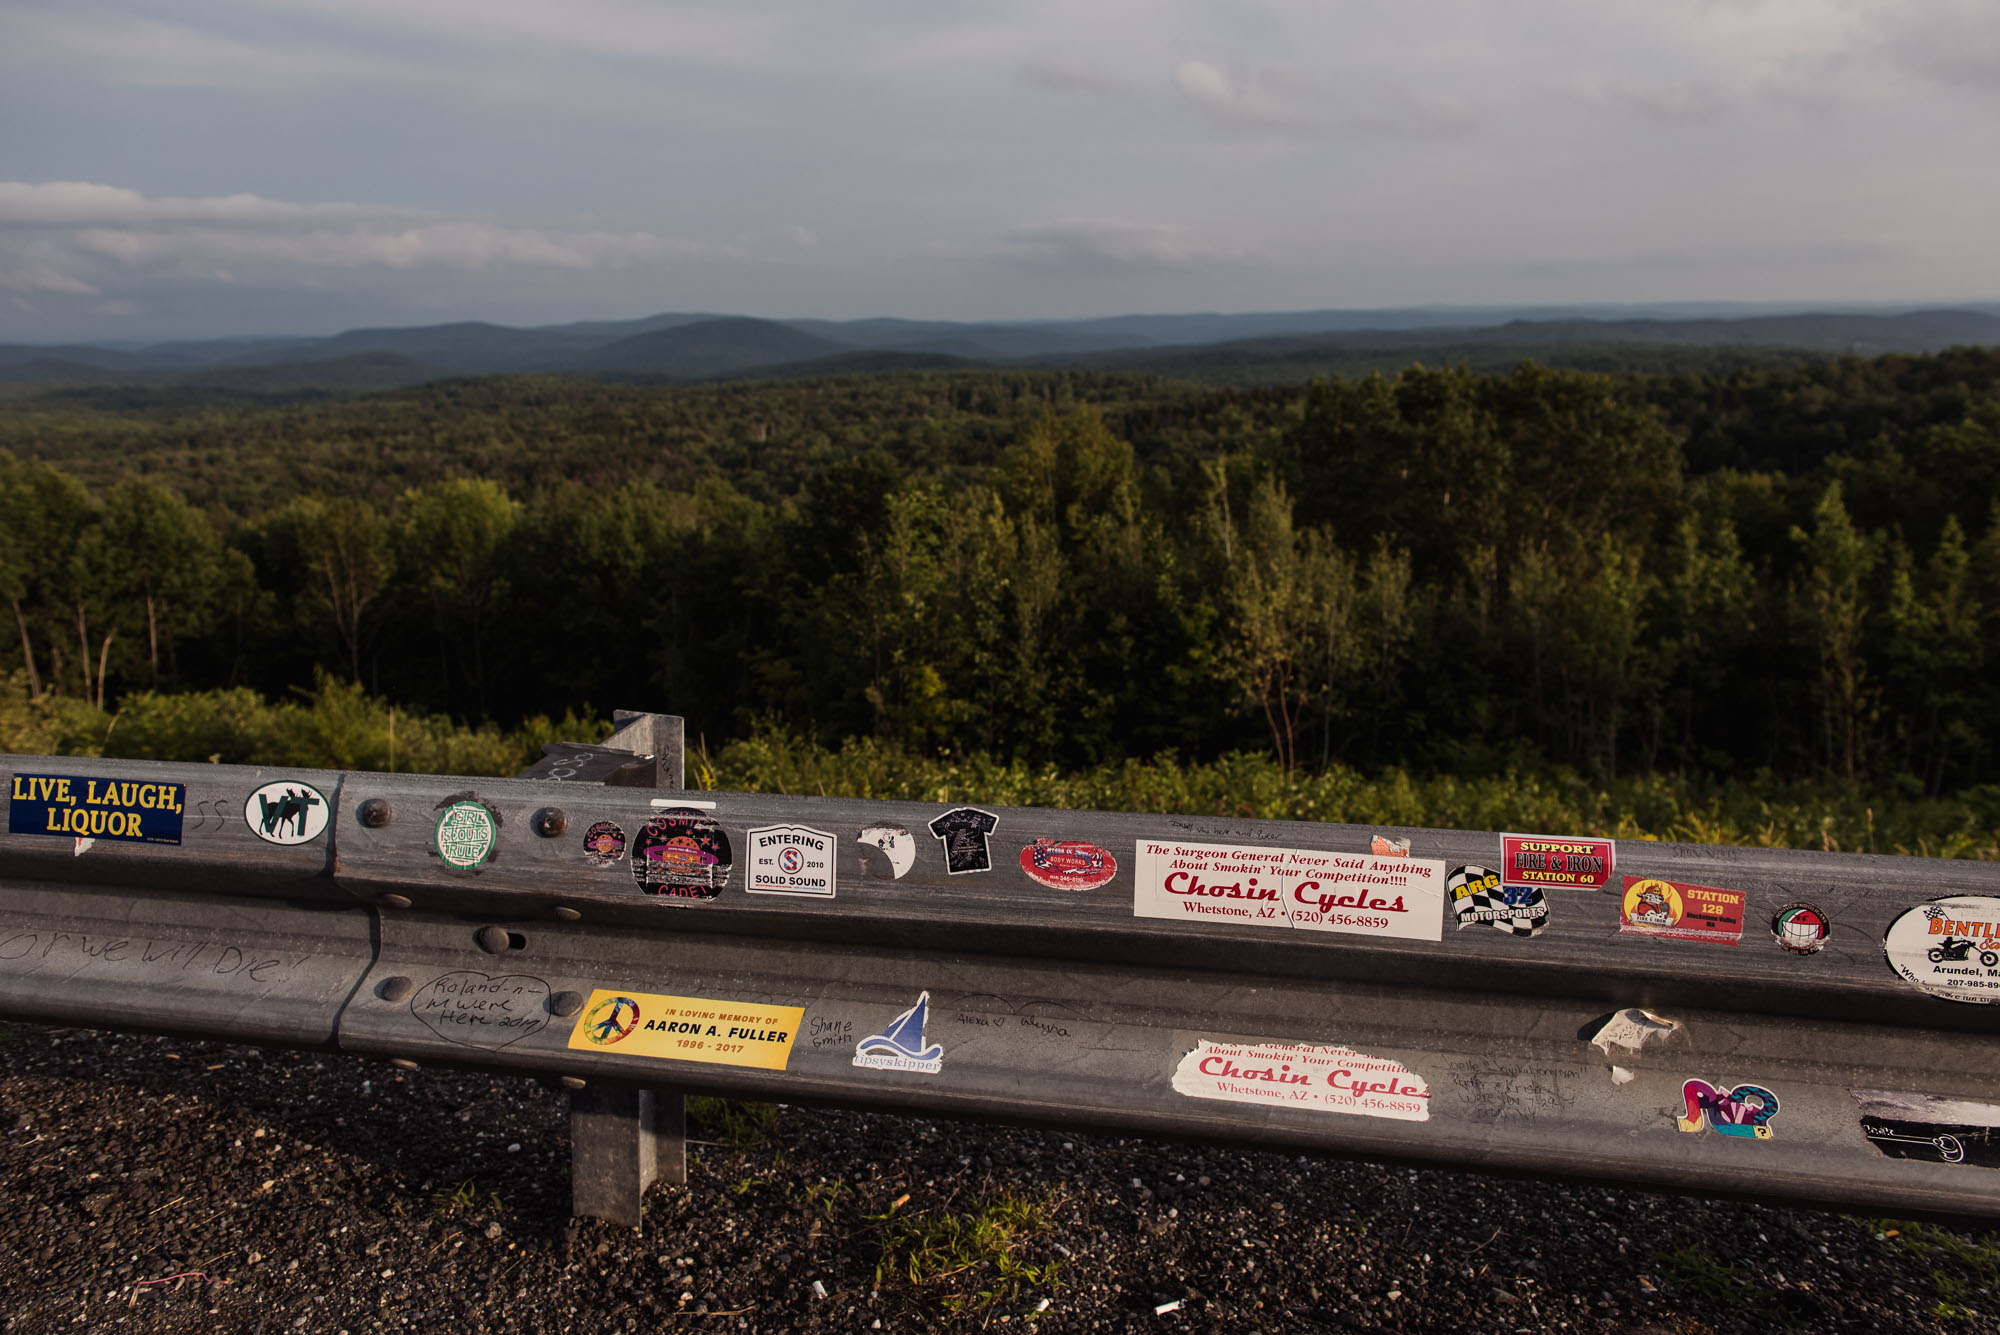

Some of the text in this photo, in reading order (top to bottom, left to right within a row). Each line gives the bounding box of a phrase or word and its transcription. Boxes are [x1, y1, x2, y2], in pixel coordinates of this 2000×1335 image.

[13, 777, 182, 814] LIVE, LAUGH,
[46, 808, 142, 837] LIQUOR
[258, 794, 320, 836] VT
[646, 812, 707, 837] COSMI
[442, 828, 489, 841] SCOUTS
[759, 834, 825, 851] ENTERING
[1520, 842, 1594, 854] SUPPORT
[758, 858, 824, 869] EST. 2010
[1146, 844, 1432, 878] The Surgeon General Never Said Anything
[1515, 852, 1604, 873] FIRE & IRON
[755, 874, 786, 885] SOLID
[789, 877, 826, 888] SOUND
[1169, 859, 1209, 872] About
[1270, 866, 1302, 877] Your
[1305, 868, 1408, 887] Competition!!!!
[1522, 870, 1595, 884] STATION 60
[1164, 872, 1409, 914] Chosin Cycles
[1455, 875, 1500, 900] ARG
[1502, 886, 1533, 905] 32
[1687, 889, 1740, 904] STATION
[1183, 901, 1389, 929] Whetstone, AZ (520) 456-8859
[1461, 907, 1545, 922] MOTORSPORTS
[1701, 903, 1724, 915] 128
[1933, 965, 1983, 977] Arundel,
[1947, 979, 2000, 989] 207-985-89
[679, 1010, 715, 1020] LOVING
[718, 1013, 762, 1024] MEMORY
[810, 1016, 852, 1036] Shane
[644, 1019, 788, 1043] AARON A. FULLER
[677, 1039, 704, 1049] 1996
[715, 1043, 744, 1053] 2017
[854, 1055, 941, 1072] tipsyskipper
[1204, 1046, 1243, 1057] About
[1301, 1055, 1334, 1066] Your
[1198, 1056, 1312, 1086] Chosin
[1217, 1081, 1421, 1113] Whetstone, AZ (520) 456-8859
